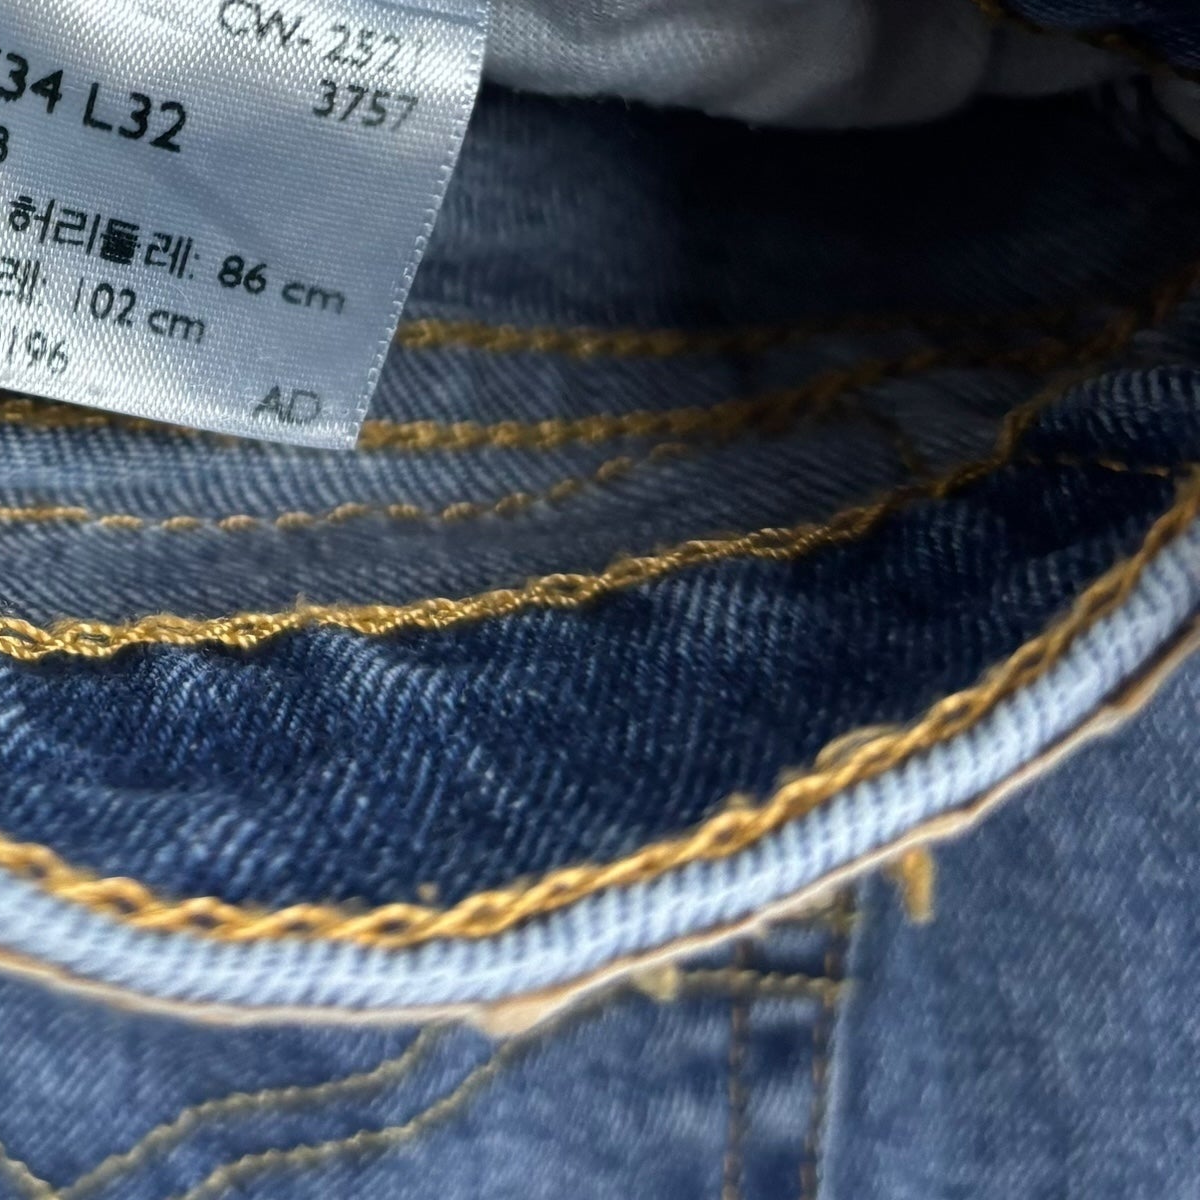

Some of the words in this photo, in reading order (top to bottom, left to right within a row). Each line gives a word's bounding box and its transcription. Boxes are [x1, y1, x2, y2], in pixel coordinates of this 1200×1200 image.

[80, 79, 192, 154] L32
[310, 75, 420, 135] 3757
[71, 274, 142, 328] 102
[144, 304, 207, 347] cm
[215, 250, 272, 298] 86
[280, 276, 347, 317] cm
[252, 378, 325, 433] AD
